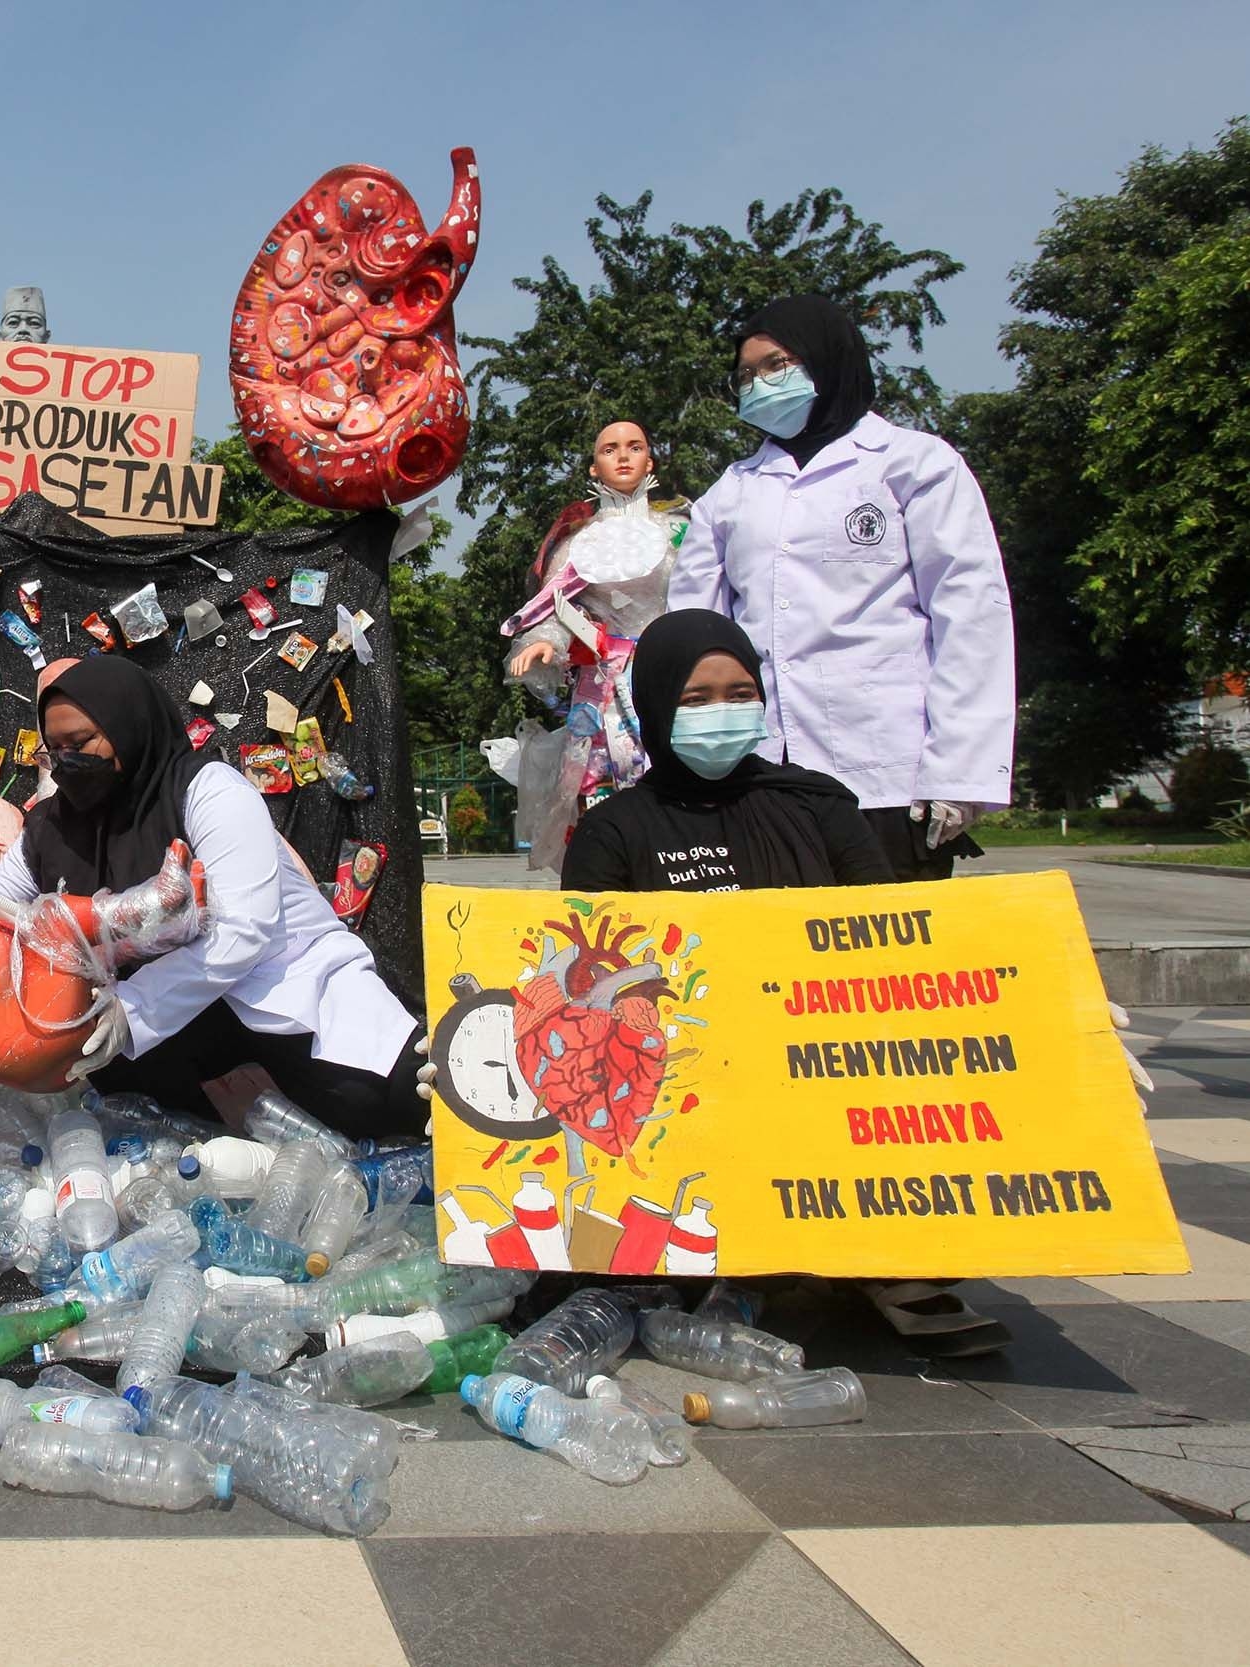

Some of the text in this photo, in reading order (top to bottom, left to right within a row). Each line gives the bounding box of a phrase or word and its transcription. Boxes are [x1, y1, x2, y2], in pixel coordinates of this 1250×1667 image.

[657, 851, 687, 865] I've
[667, 868, 698, 885] but
[805, 909, 933, 952] DENYUT
[497, 1010, 509, 1018] 12
[786, 1034, 1017, 1079] MENYIMPAN
[470, 1088, 478, 1099] 8
[510, 1103, 518, 1114] 6
[846, 1101, 1003, 1146] BAHAYA
[771, 1170, 1113, 1220] TAK KASAT MATA
